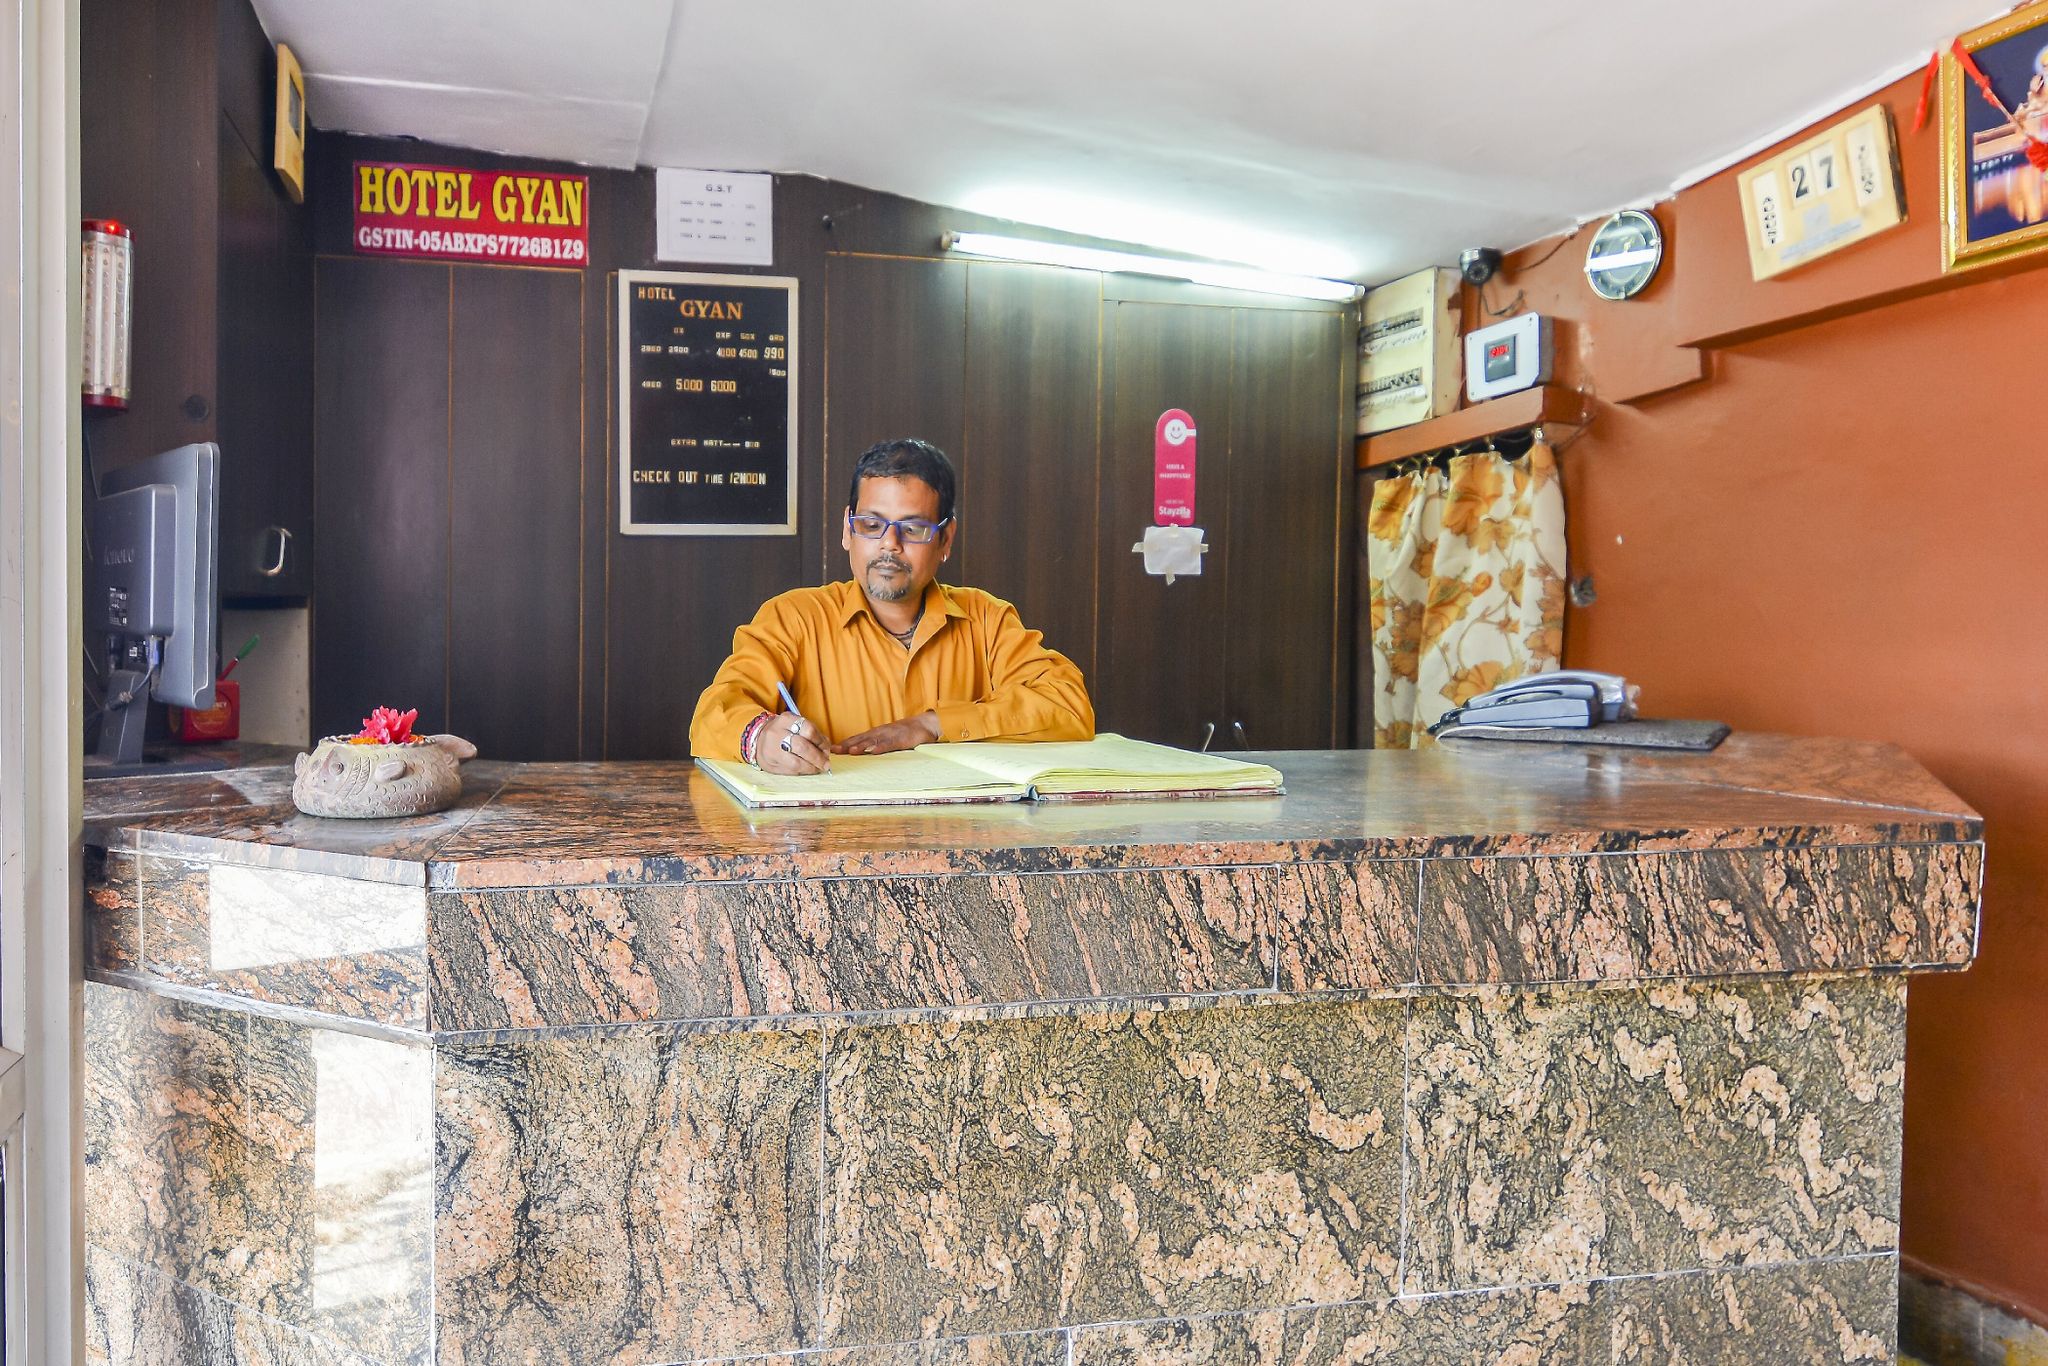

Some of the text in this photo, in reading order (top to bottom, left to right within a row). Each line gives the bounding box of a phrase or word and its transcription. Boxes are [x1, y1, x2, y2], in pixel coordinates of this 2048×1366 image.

[1791, 156, 1833, 199] 27
[358, 166, 584, 226] HOTEL GYAN
[638, 287, 676, 300] HOTEL
[680, 299, 743, 320] GYAN
[764, 347, 785, 360] 990
[675, 378, 703, 391] 5000
[710, 380, 737, 393] 6000
[633, 470, 671, 484] CHECK
[678, 471, 698, 484] OUT
[705, 473, 723, 485] TIME
